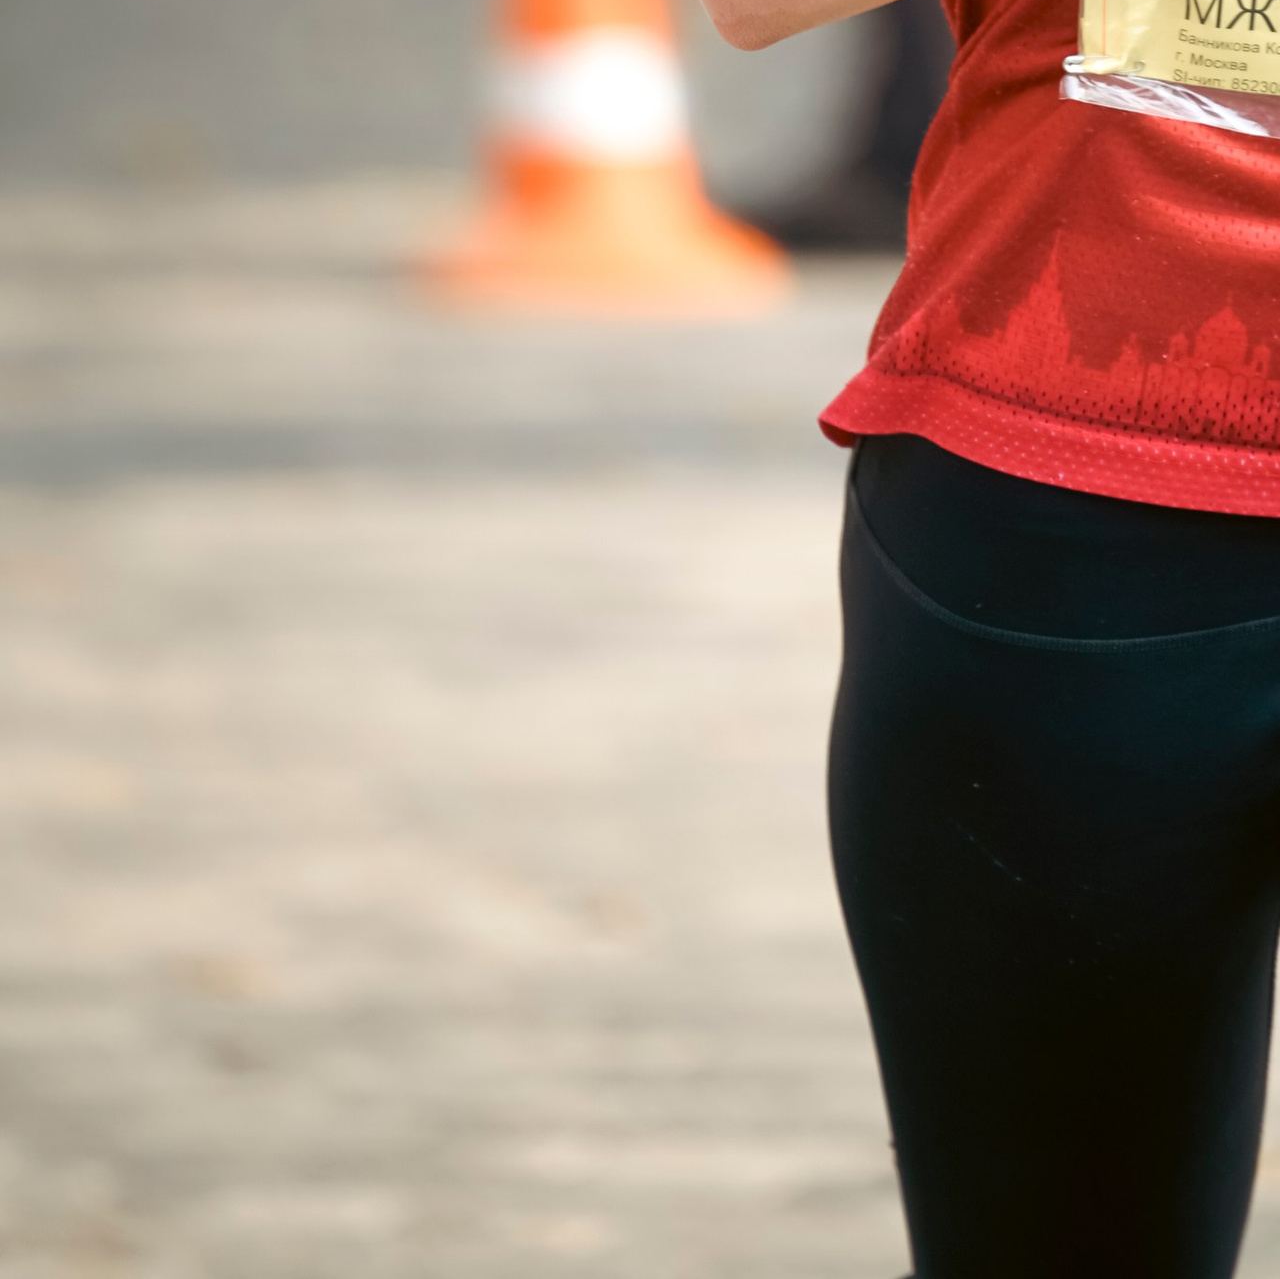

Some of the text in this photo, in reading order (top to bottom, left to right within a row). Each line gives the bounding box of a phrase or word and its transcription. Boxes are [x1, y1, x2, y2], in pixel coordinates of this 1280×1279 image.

[1178, 28, 1261, 54] Банникова
[1174, 51, 1248, 72] г. Москва
[1172, 68, 1226, 88] SI-чип:
